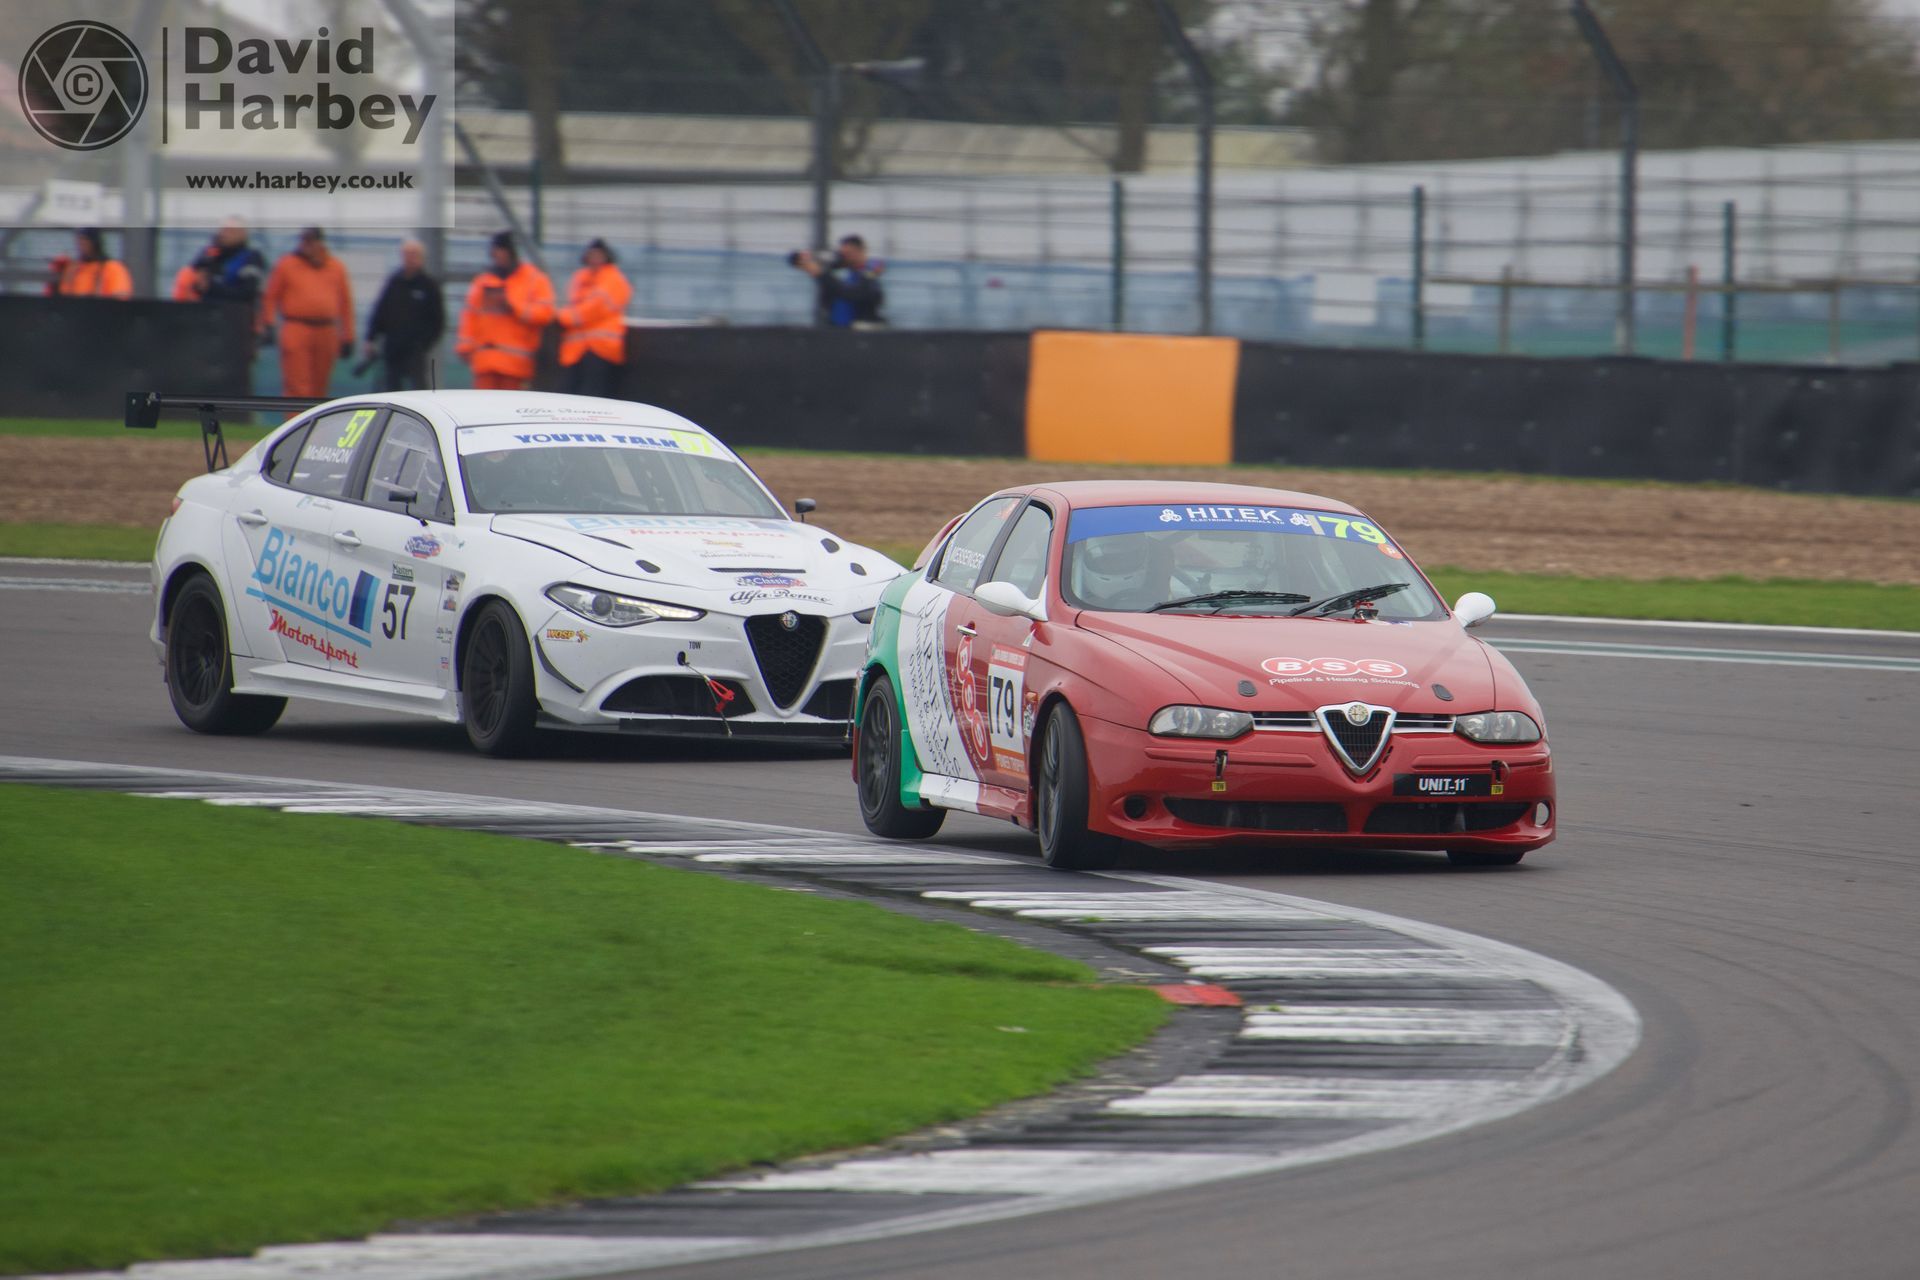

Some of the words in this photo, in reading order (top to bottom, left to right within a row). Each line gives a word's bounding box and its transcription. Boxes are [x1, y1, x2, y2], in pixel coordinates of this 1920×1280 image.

[337, 410, 377, 448] 57
[513, 434, 607, 444] YOUTH
[611, 435, 680, 449] TALK
[671, 430, 713, 455] 57
[1186, 507, 1283, 521] HITEK
[564, 516, 744, 530] Bianco
[252, 526, 350, 619] Bianco
[753, 577, 789, 585] Classic
[730, 590, 767, 605] Alfa
[772, 589, 831, 602] Romeo
[381, 583, 416, 640] 57
[269, 609, 358, 669] Motorsport
[546, 629, 576, 640] WOSP
[689, 641, 702, 650] TOW
[1275, 660, 1396, 675] BSS
[1269, 677, 1312, 686] Pipeline
[1370, 678, 1420, 689] Solutions
[1419, 778, 1466, 791] UNIT-11
